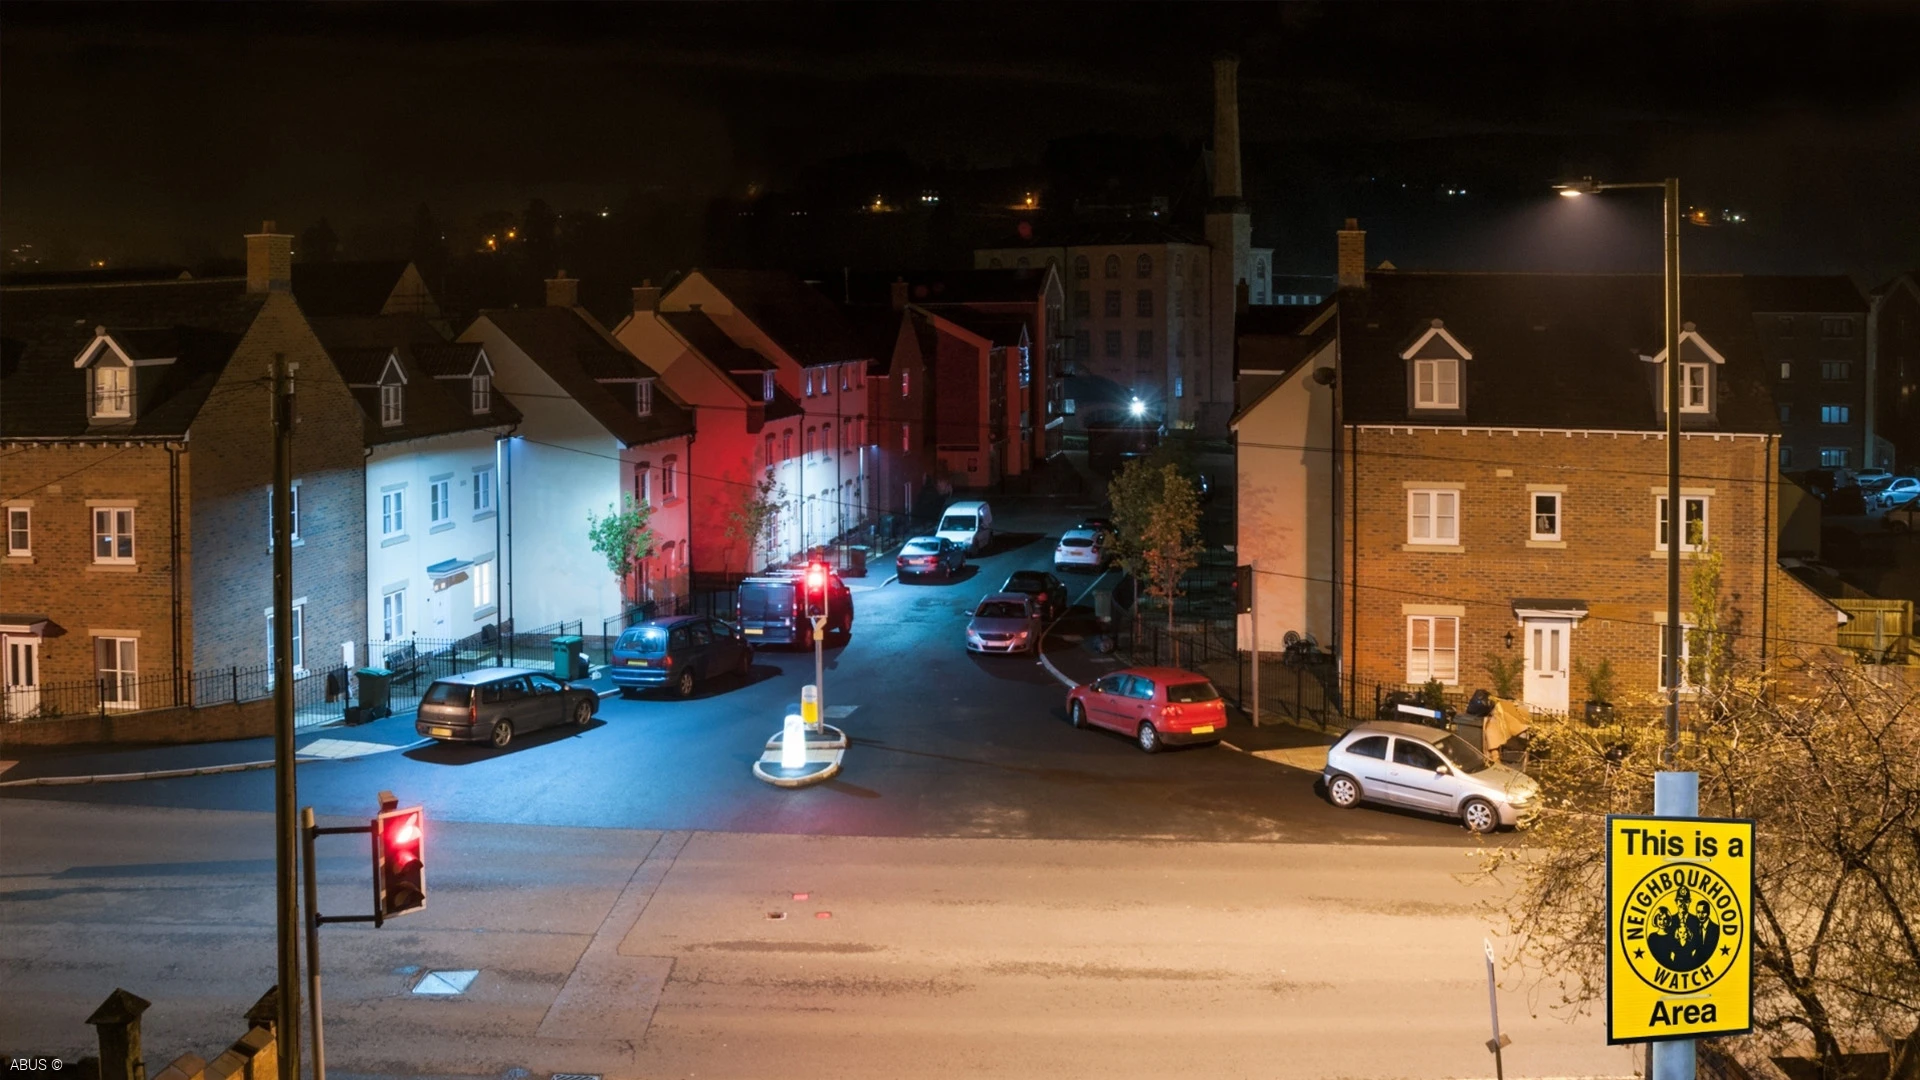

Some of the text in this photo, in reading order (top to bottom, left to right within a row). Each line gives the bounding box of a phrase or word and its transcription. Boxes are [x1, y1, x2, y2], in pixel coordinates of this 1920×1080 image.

[1620, 828, 1743, 858] This is a
[1627, 868, 1738, 941] NEIGHBOURHOOD
[1653, 964, 1715, 990] WATCH
[1649, 1000, 1717, 1027] Area
